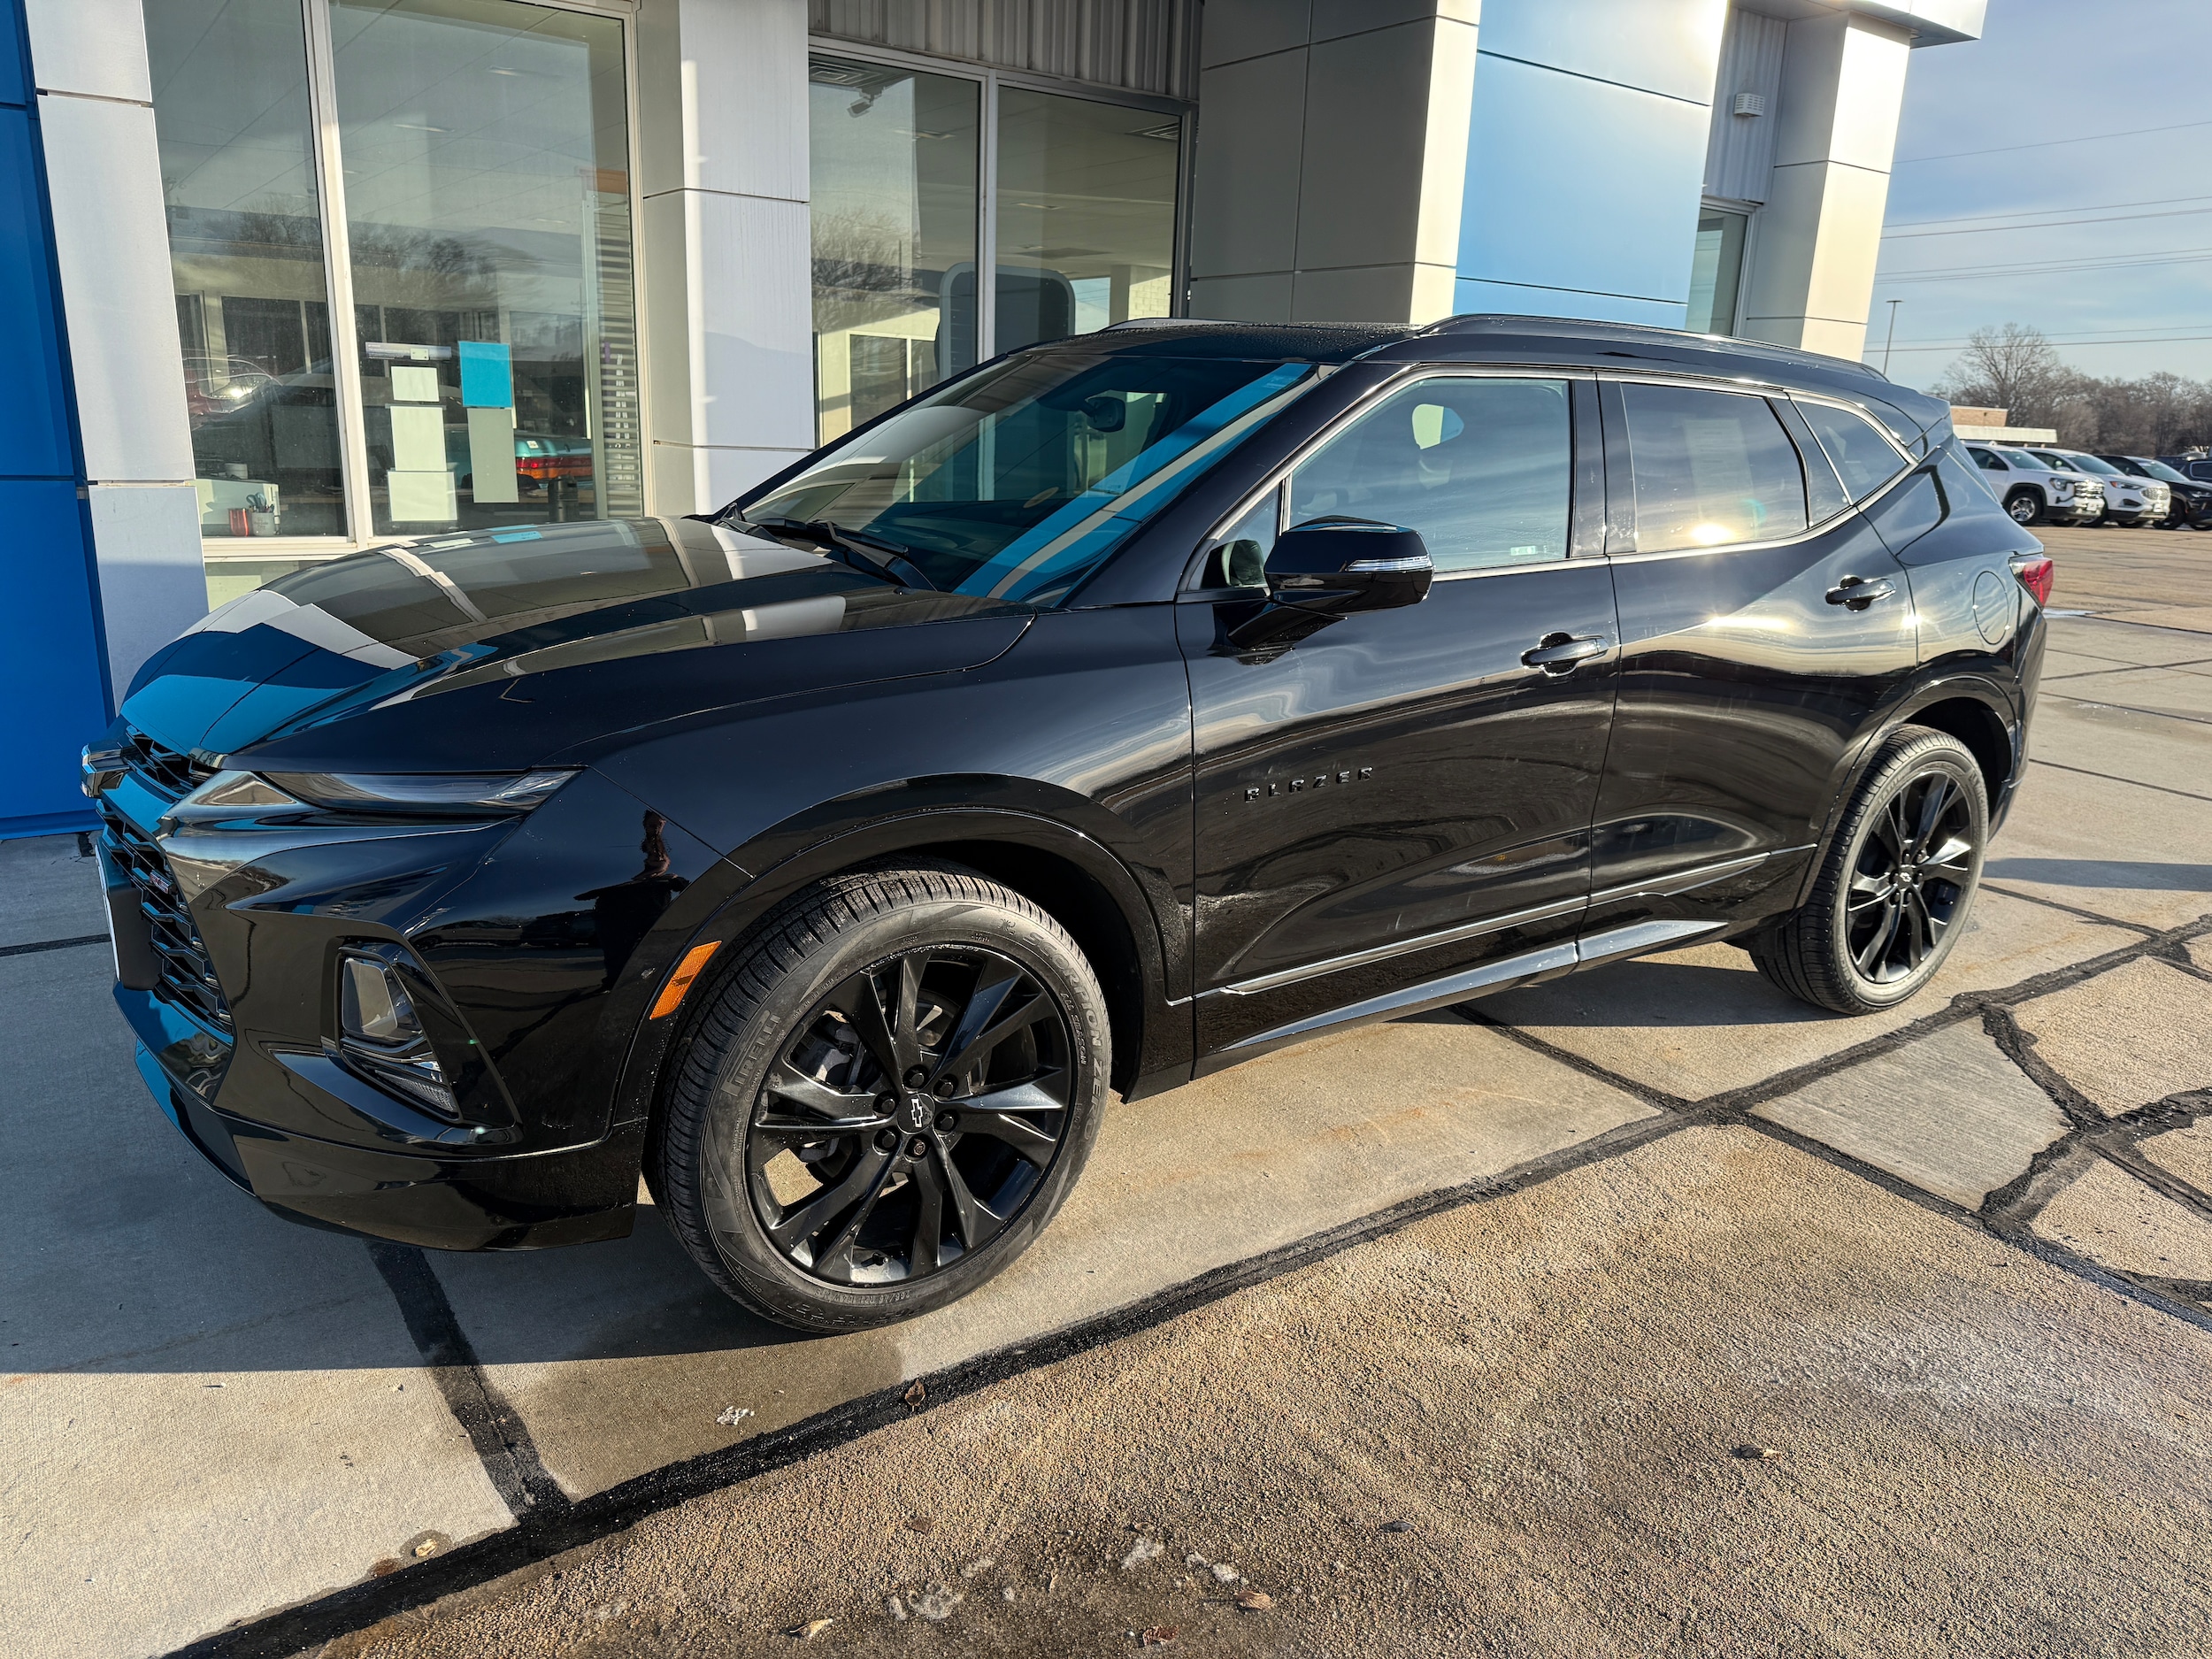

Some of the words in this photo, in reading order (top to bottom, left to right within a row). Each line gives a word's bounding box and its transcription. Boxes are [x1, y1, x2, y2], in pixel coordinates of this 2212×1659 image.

[1244, 766, 1373, 803] BLAZER
[720, 1010, 782, 1097] PIRELLI
[1022, 932, 1102, 1047] SCORPION
[1083, 1057, 1102, 1141] ZERO
[1060, 992, 1075, 1011] ALL
[1071, 1014, 1087, 1066] SEASON
